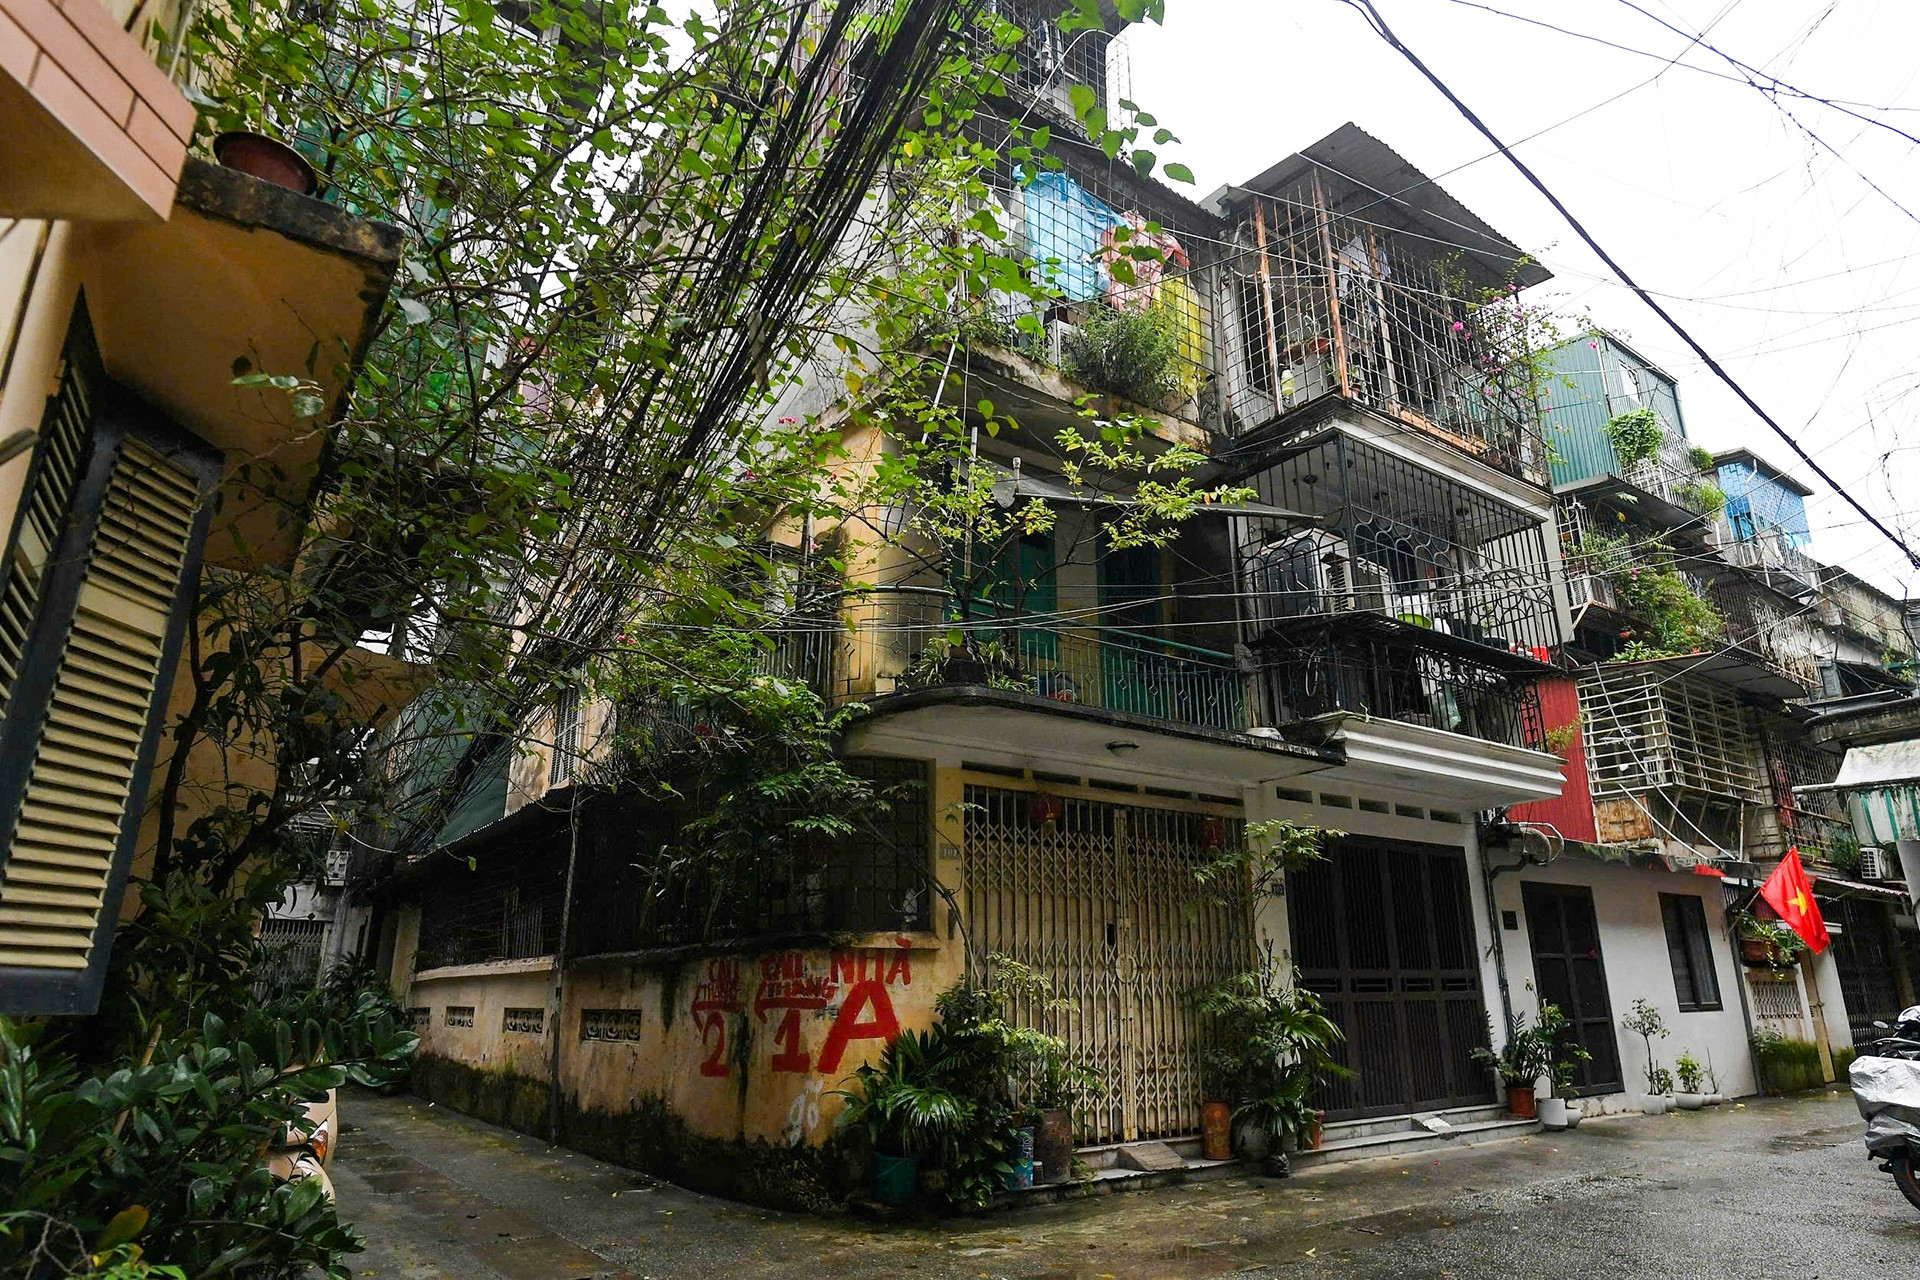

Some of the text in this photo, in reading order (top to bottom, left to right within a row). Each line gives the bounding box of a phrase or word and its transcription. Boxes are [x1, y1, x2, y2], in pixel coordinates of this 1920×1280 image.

[830, 935, 912, 984] NHÀ
[700, 1012, 730, 1077] 2
[772, 1010, 811, 1073] 1
[817, 979, 901, 1074] A
